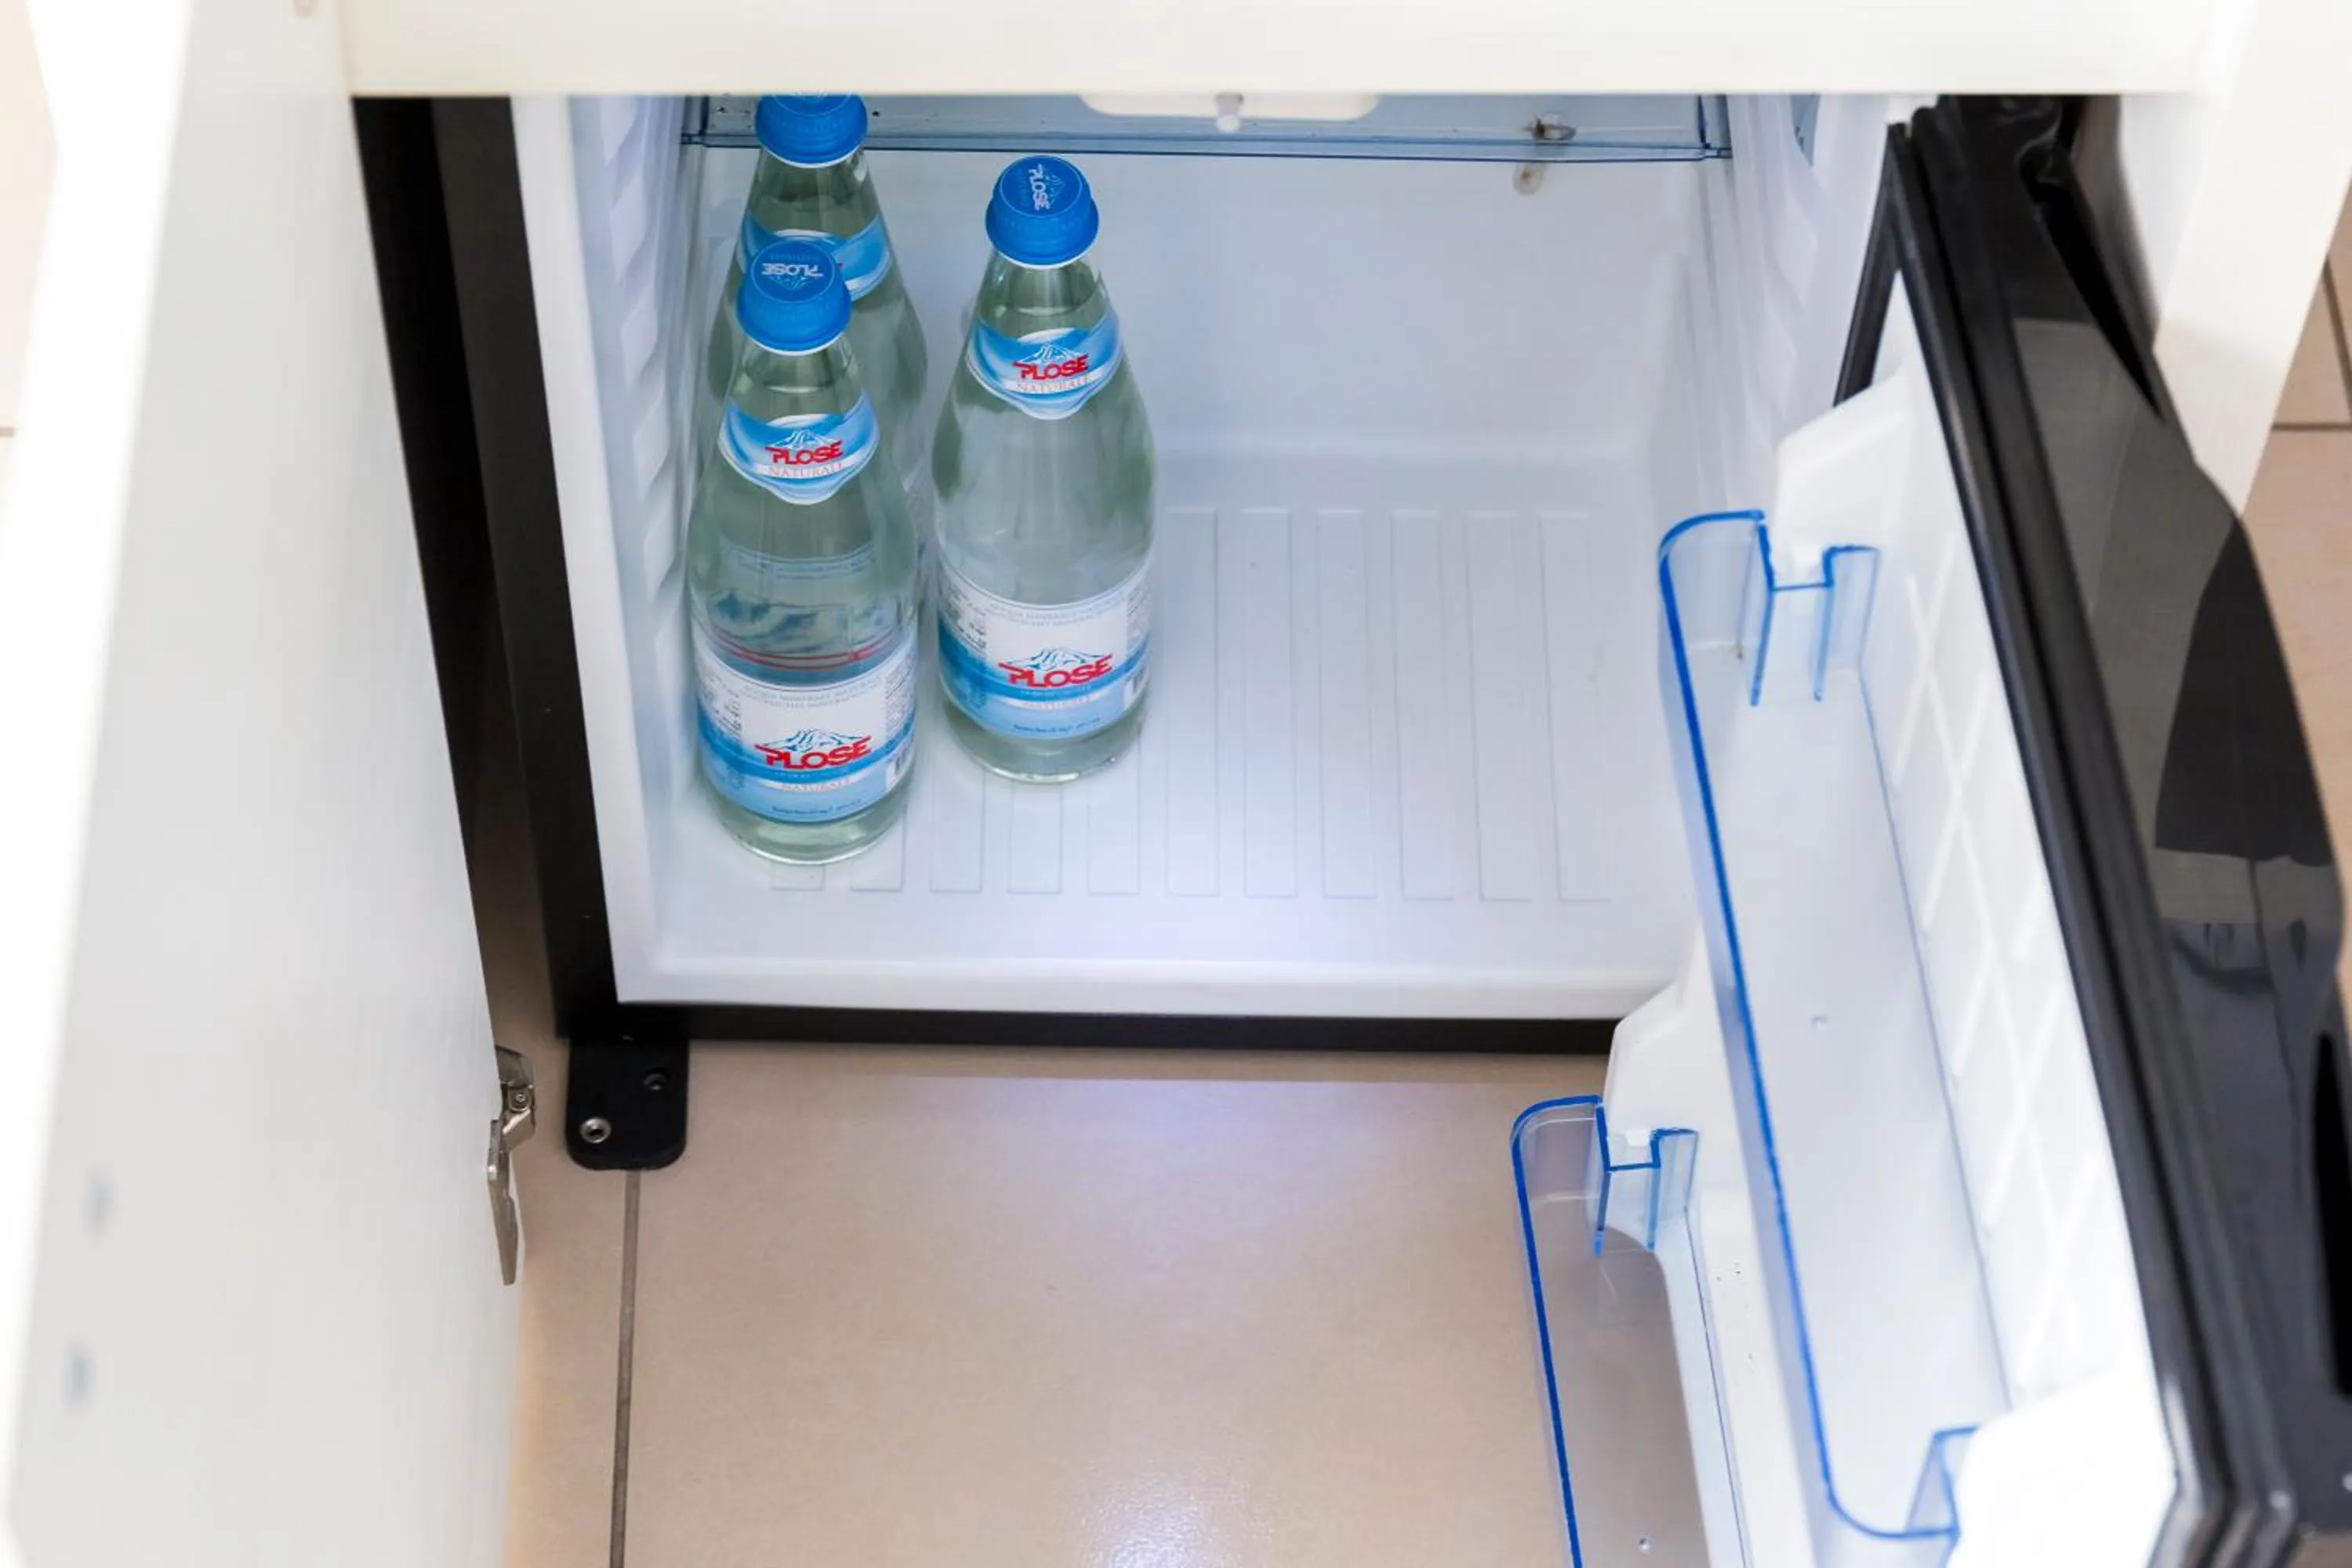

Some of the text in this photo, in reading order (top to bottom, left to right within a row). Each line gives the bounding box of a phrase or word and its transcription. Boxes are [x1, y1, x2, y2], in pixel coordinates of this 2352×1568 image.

[1028, 163, 1051, 211] PLOSE
[761, 263, 824, 277] PLOSE
[1012, 354, 1089, 380] PLOSE
[764, 440, 844, 465] PLOSE
[997, 653, 1112, 688] PLOSE
[754, 735, 873, 769] PLOSE
